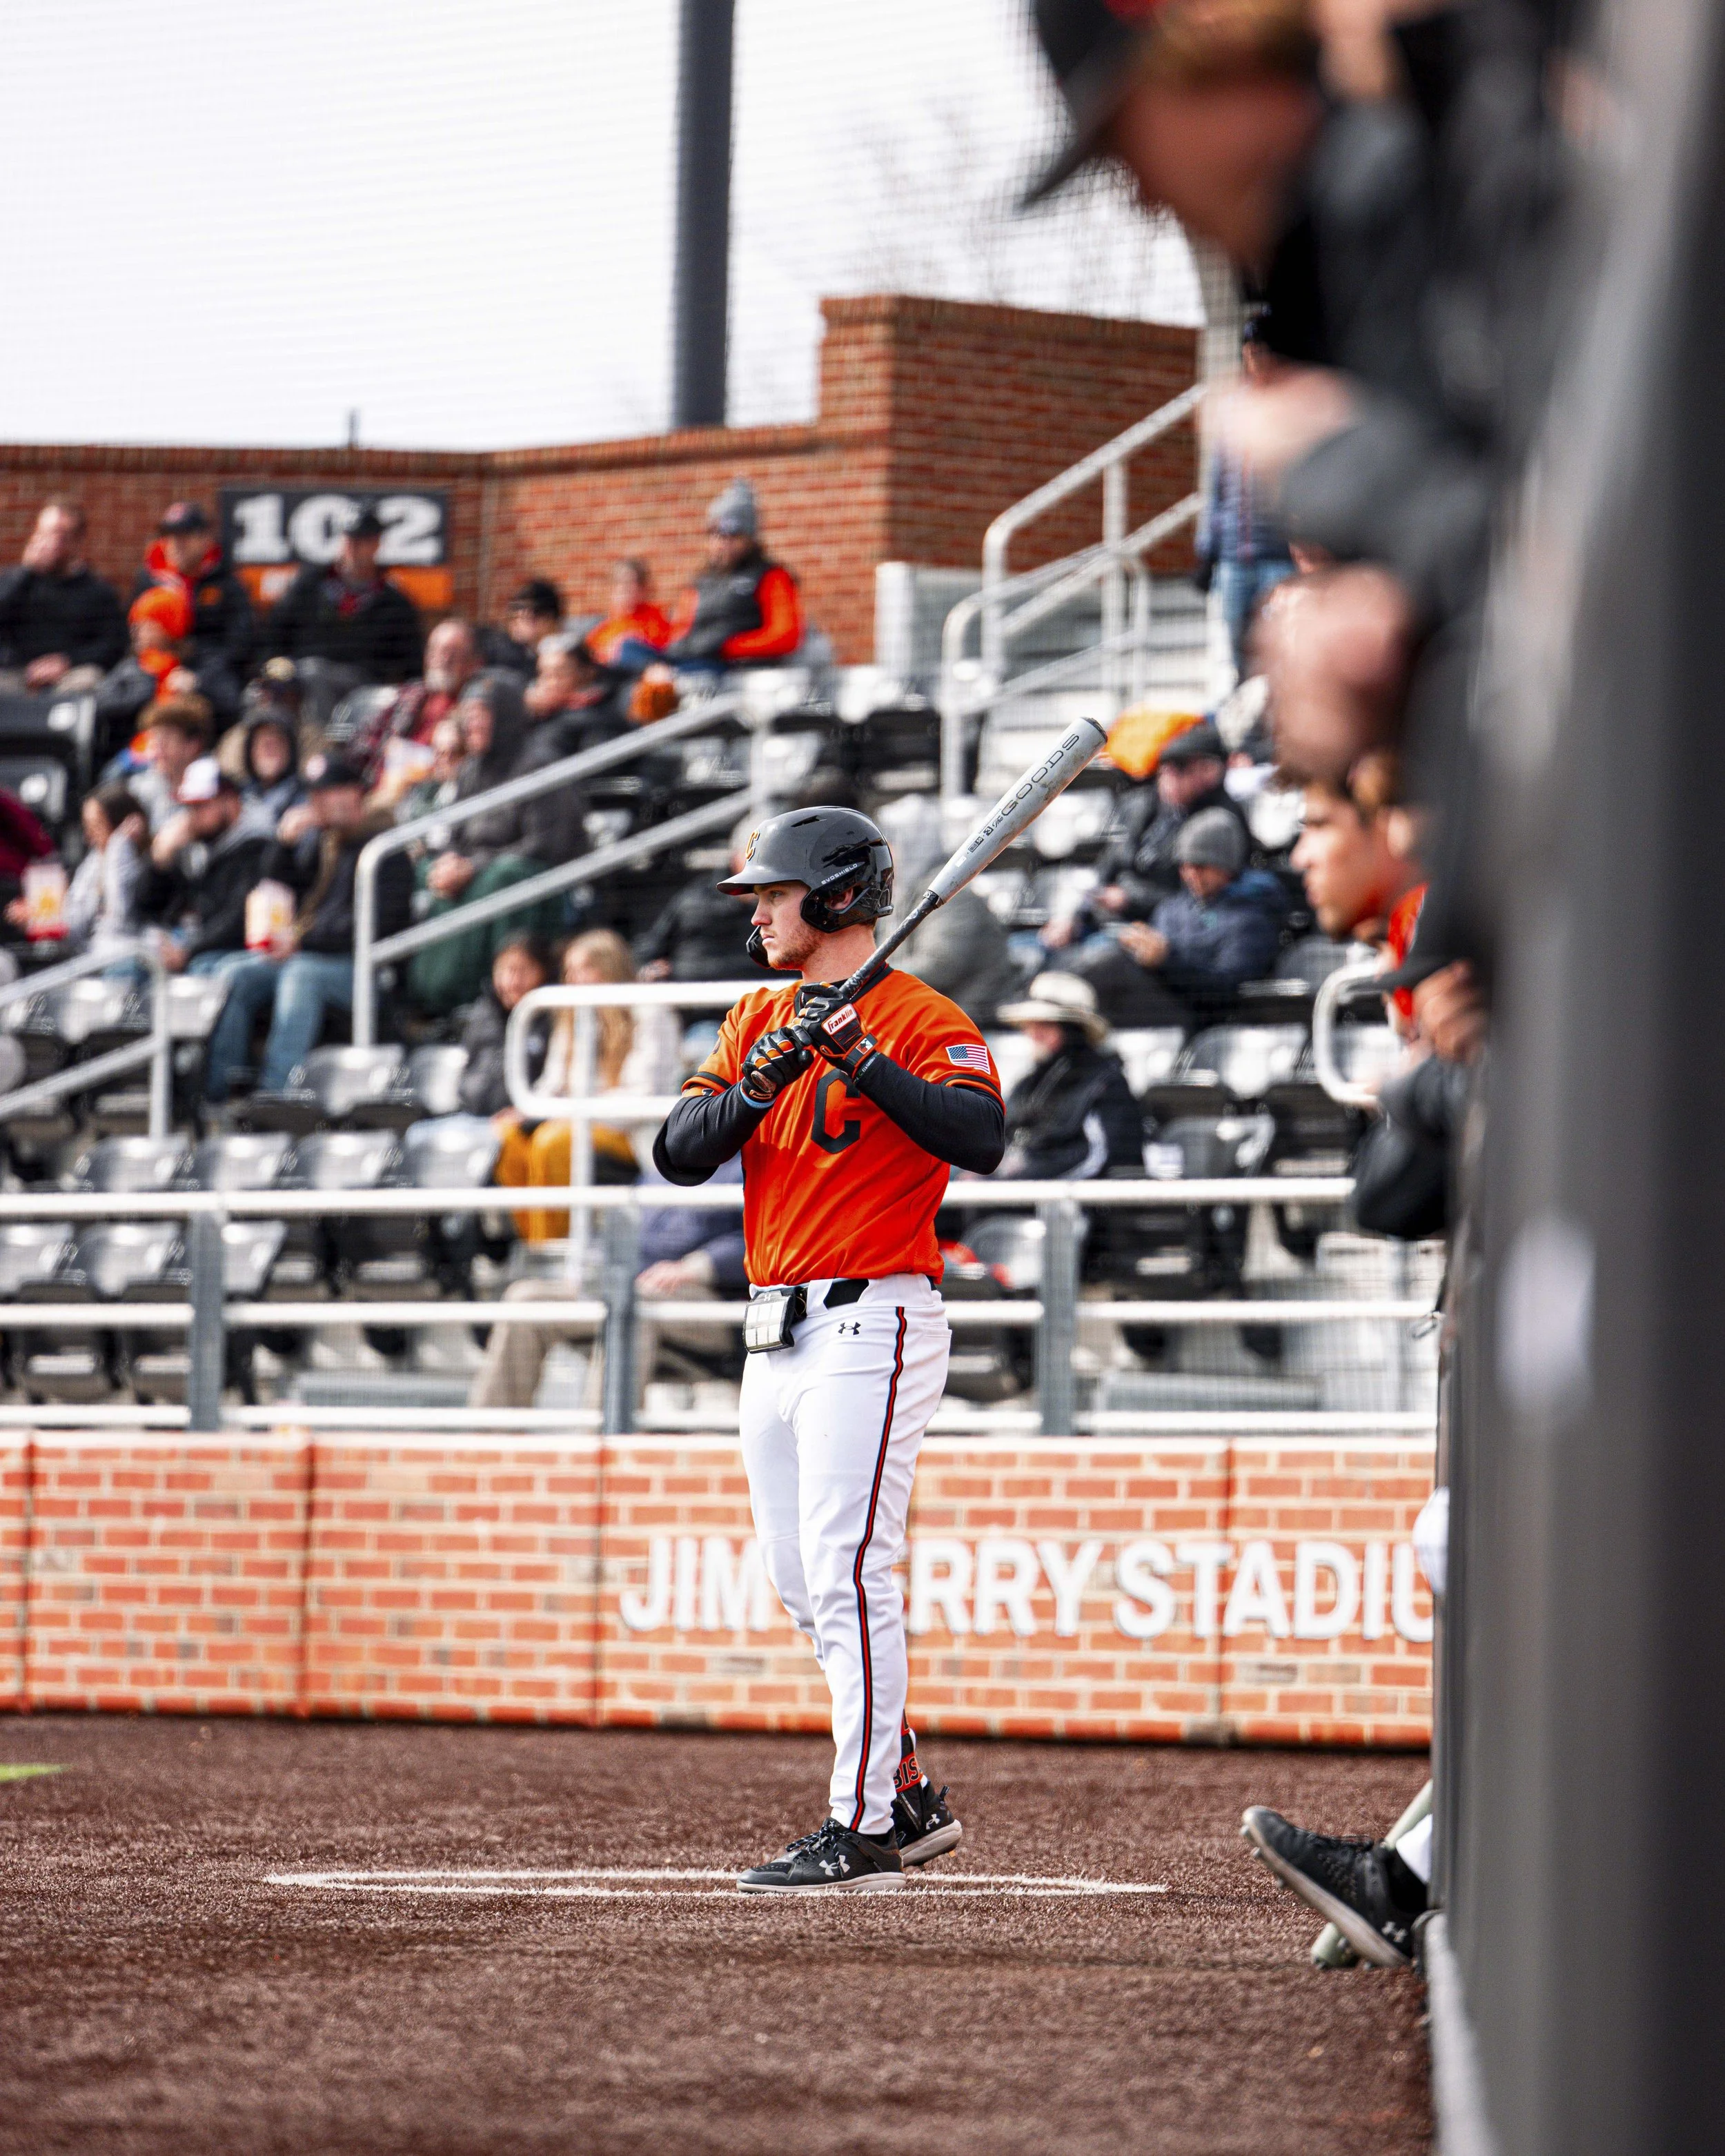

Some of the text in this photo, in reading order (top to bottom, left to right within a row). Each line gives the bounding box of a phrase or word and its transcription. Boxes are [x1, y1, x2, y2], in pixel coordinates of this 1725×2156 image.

[233, 493, 442, 565] 102
[1001, 733, 1079, 816] GOODS
[746, 828, 760, 862] C
[821, 863, 858, 884] EVOSHIELD
[811, 1068, 861, 1154] C
[620, 1536, 771, 1632] JIM
[891, 1538, 1103, 1637] RRY
